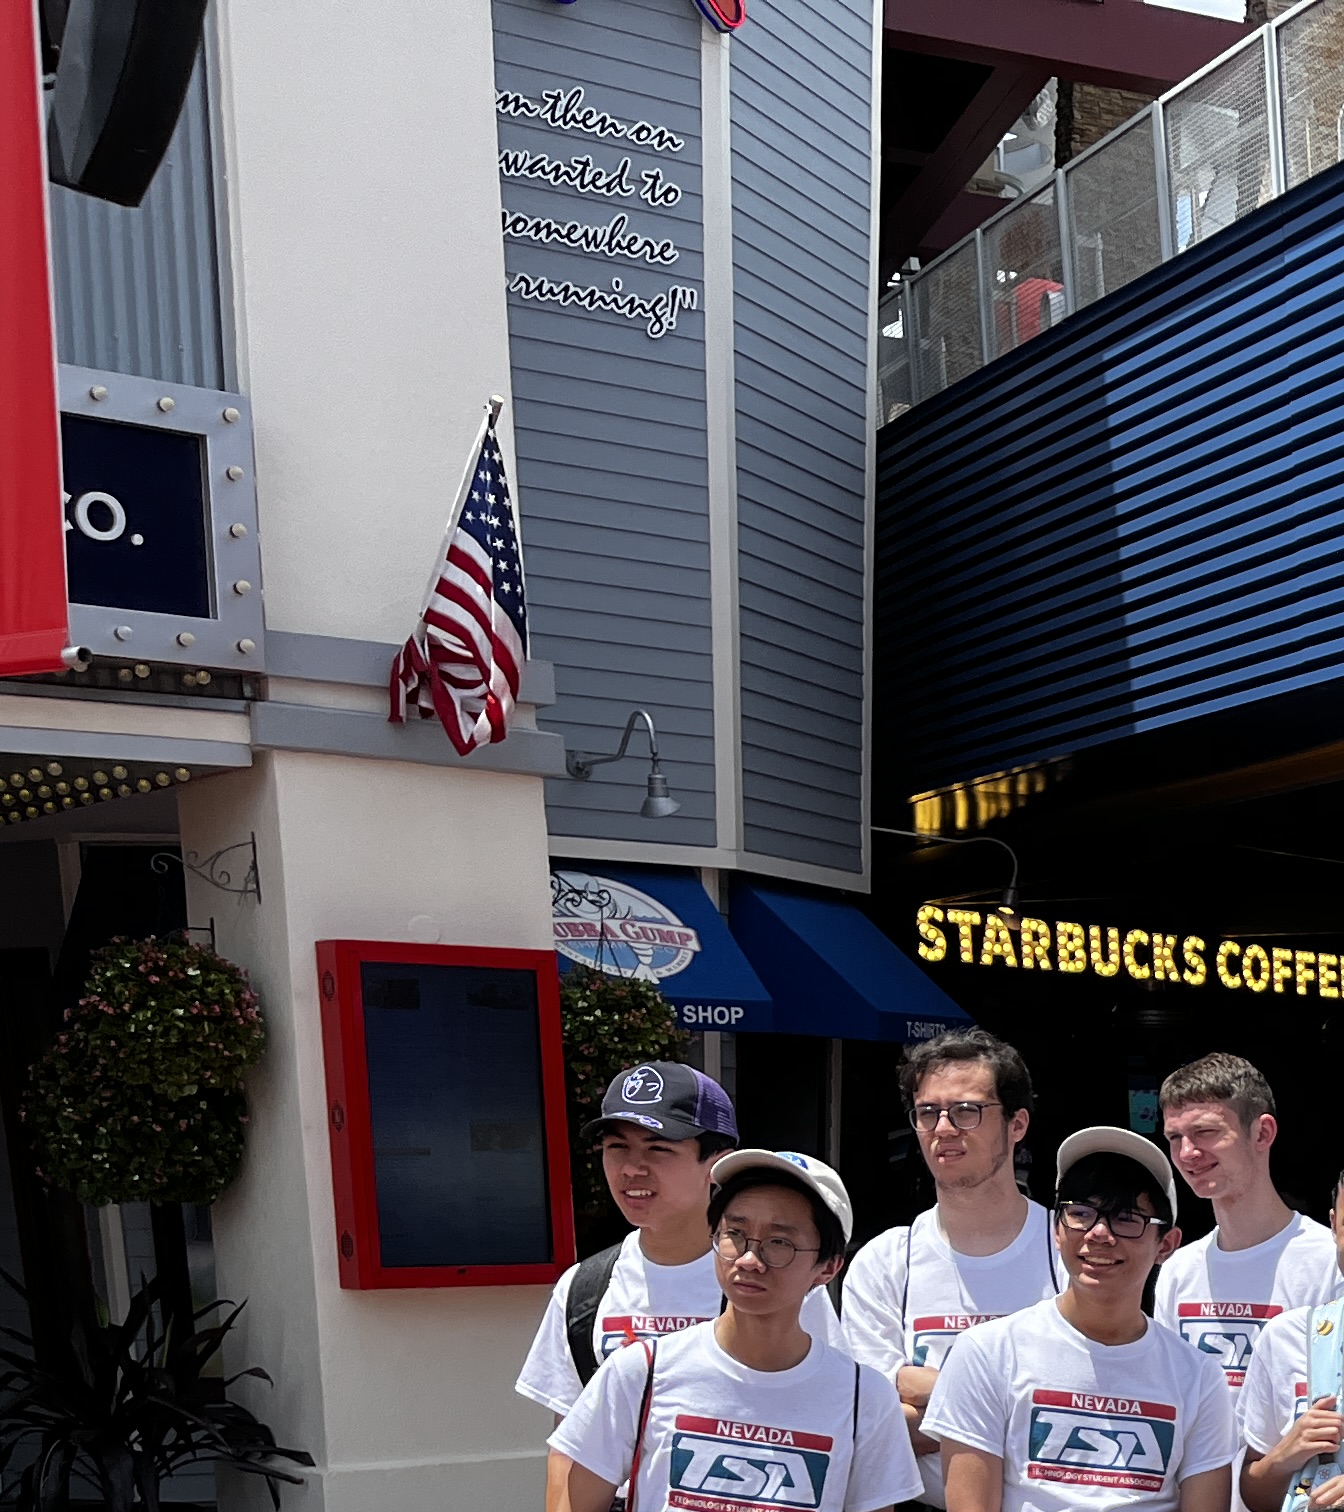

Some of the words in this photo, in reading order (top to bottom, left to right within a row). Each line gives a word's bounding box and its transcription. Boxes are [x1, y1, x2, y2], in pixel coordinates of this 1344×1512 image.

[541, 86, 627, 137] then
[627, 121, 685, 152] on
[499, 149, 635, 197] wanted
[640, 167, 682, 207] to
[510, 272, 698, 338] running!"
[63, 491, 144, 546] O.
[553, 921, 619, 939] UBBA
[619, 921, 694, 947] GUMP
[916, 904, 1206, 986] STARBUCKS
[682, 1004, 745, 1025] SHOP
[1200, 1303, 1253, 1317] NEVADA
[631, 1316, 699, 1331] NEVADA
[1071, 1393, 1142, 1415] NEVADA
[716, 1420, 795, 1446] NEVADA
[1035, 1410, 1165, 1471] TSA
[676, 1436, 817, 1505] TSA
[1082, 1474, 1119, 1484] STUDENT
[674, 1494, 726, 1511] TECHNOLOGY
